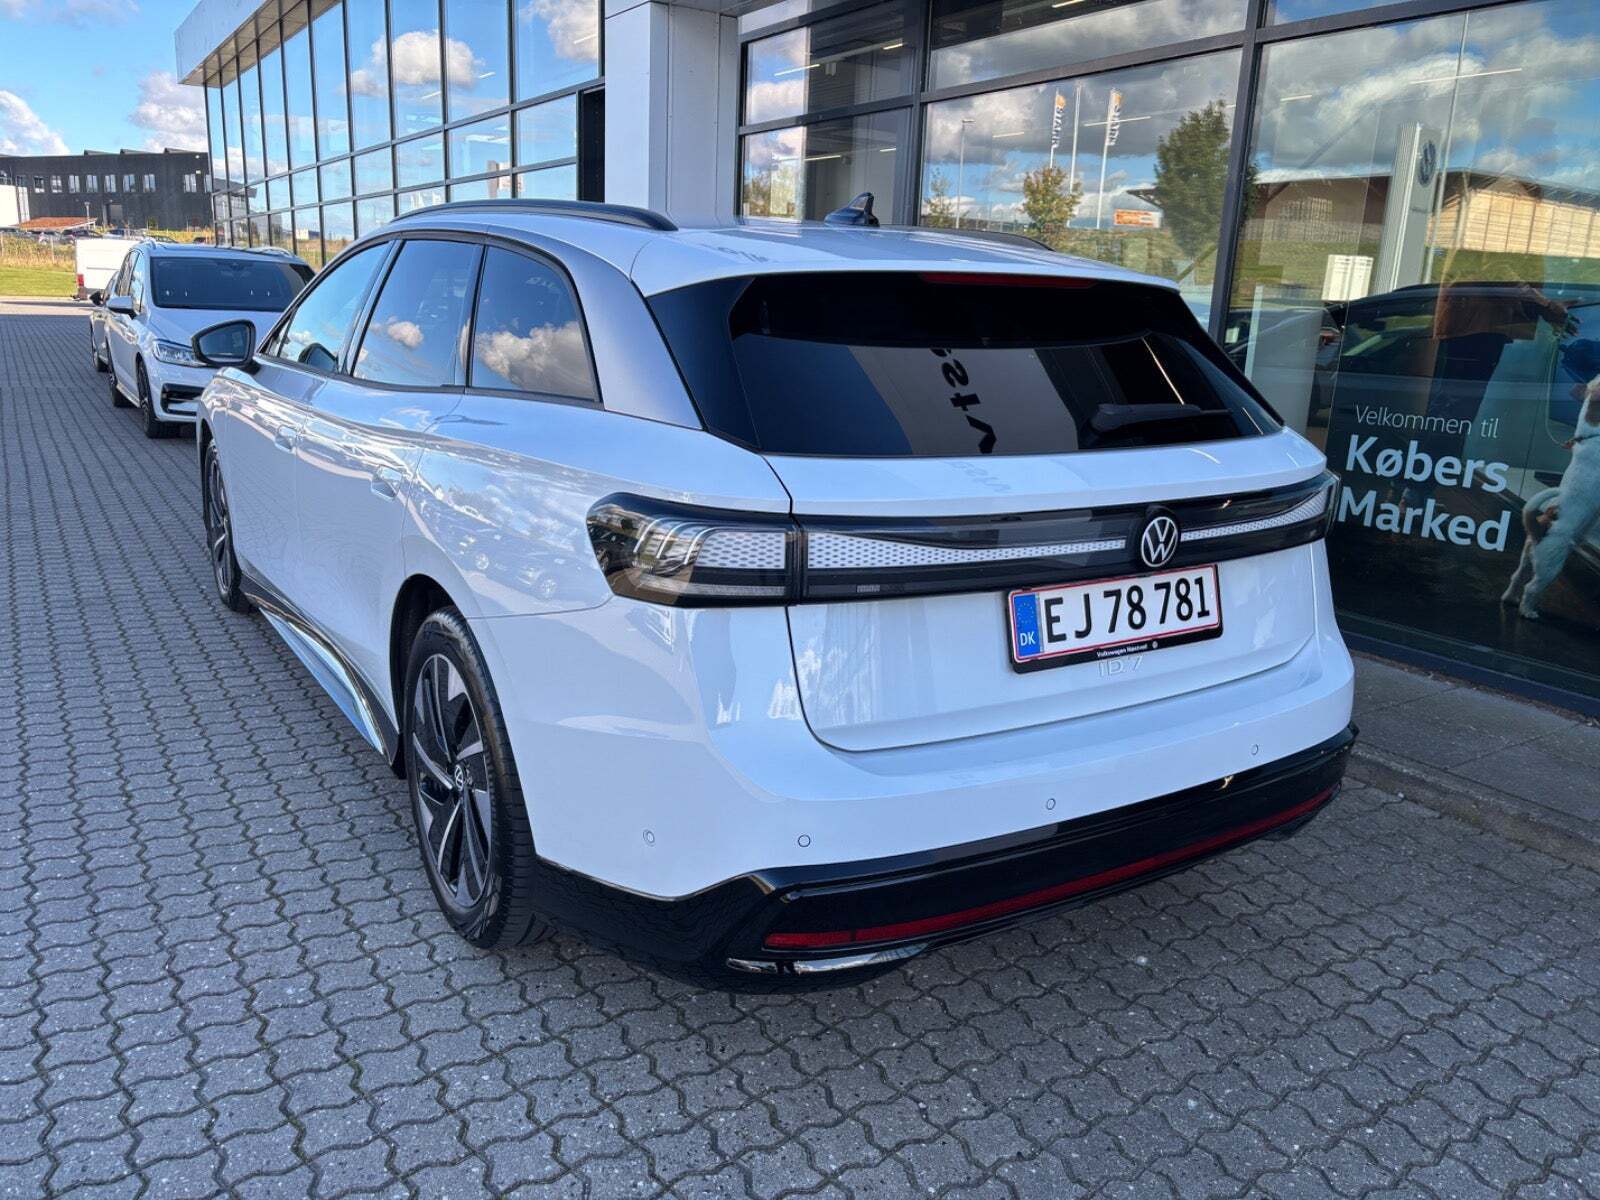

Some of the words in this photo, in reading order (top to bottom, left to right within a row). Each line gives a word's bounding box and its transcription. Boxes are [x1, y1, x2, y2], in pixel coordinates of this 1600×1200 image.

[1355, 404, 1472, 435] Velkommen
[1481, 417, 1499, 439] til
[1345, 434, 1510, 493] Købers
[1337, 486, 1512, 552] Marked
[1044, 593, 1092, 643] EJ
[1103, 585, 1146, 634] 78
[1154, 576, 1210, 625] 781
[1020, 632, 1036, 647] DK
